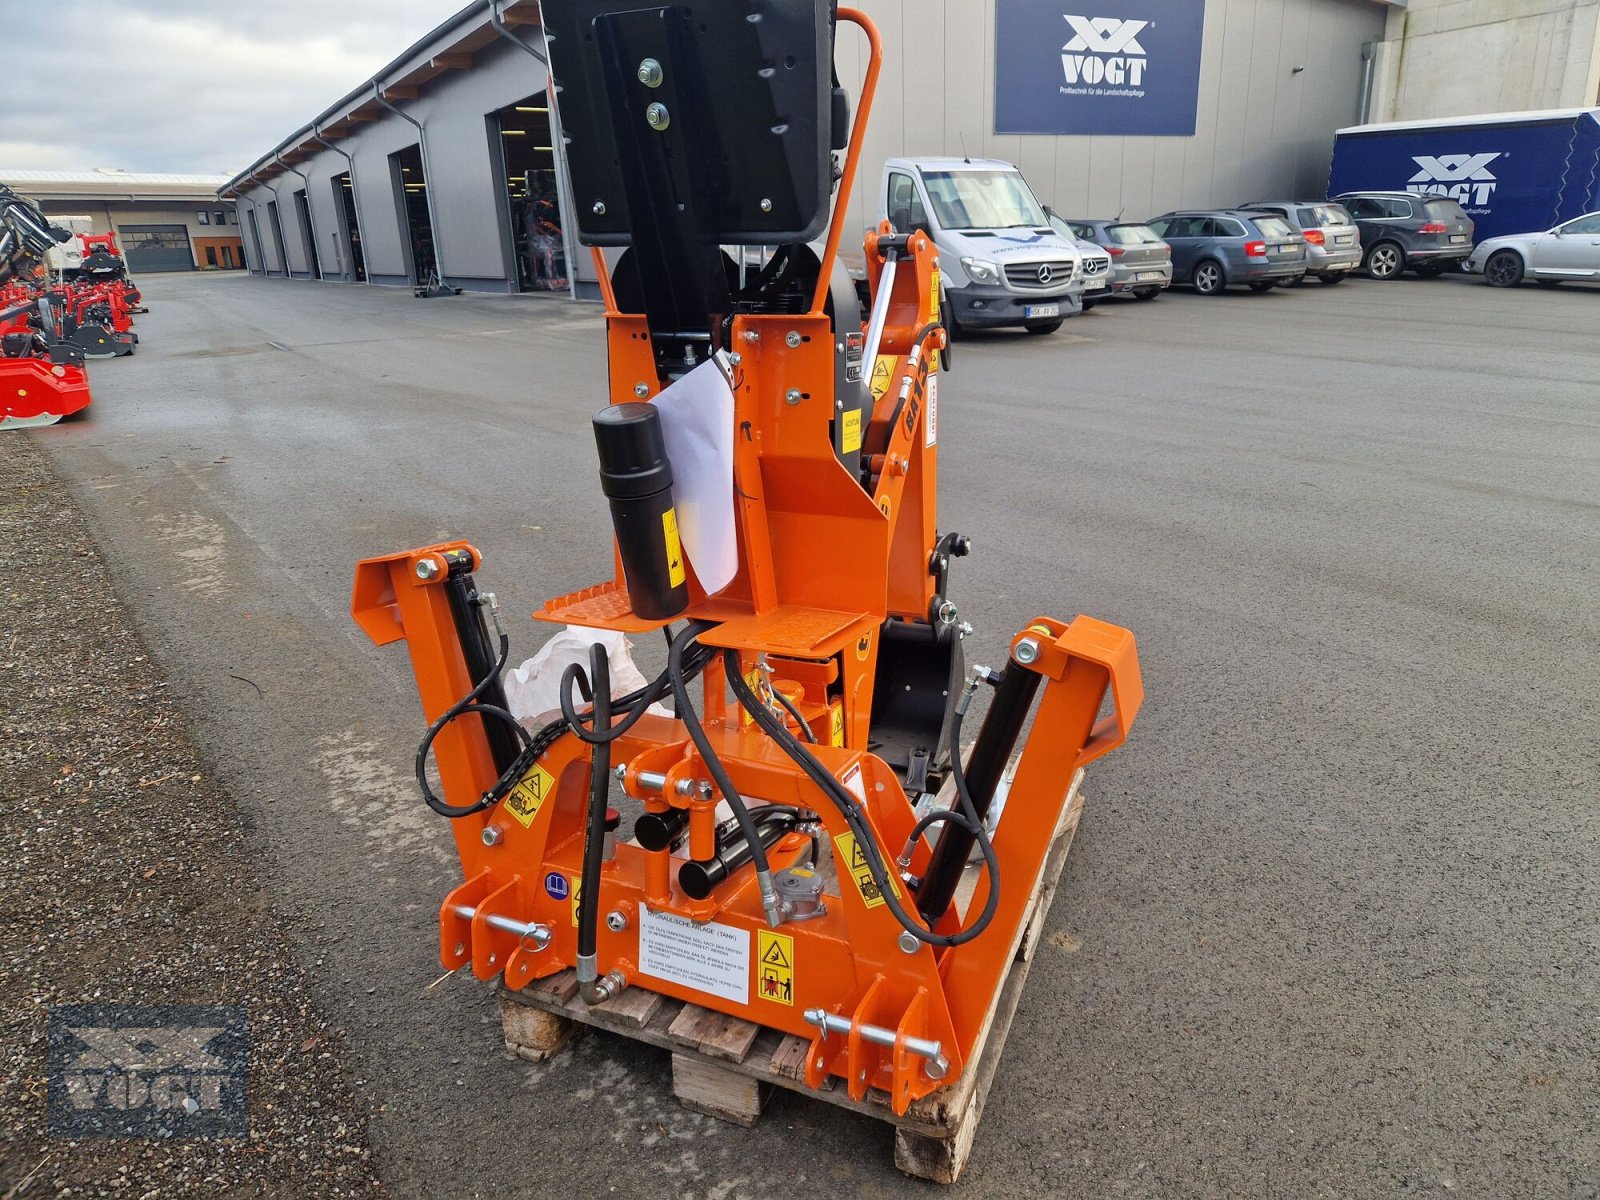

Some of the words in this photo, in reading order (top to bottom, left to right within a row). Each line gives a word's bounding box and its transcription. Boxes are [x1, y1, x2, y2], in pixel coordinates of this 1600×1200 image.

[1061, 54, 1147, 86] VOGT
[1060, 86, 1088, 94] Profitechnik
[1104, 88, 1145, 98] Landschaftspflege
[691, 922, 714, 934] ANLAGE
